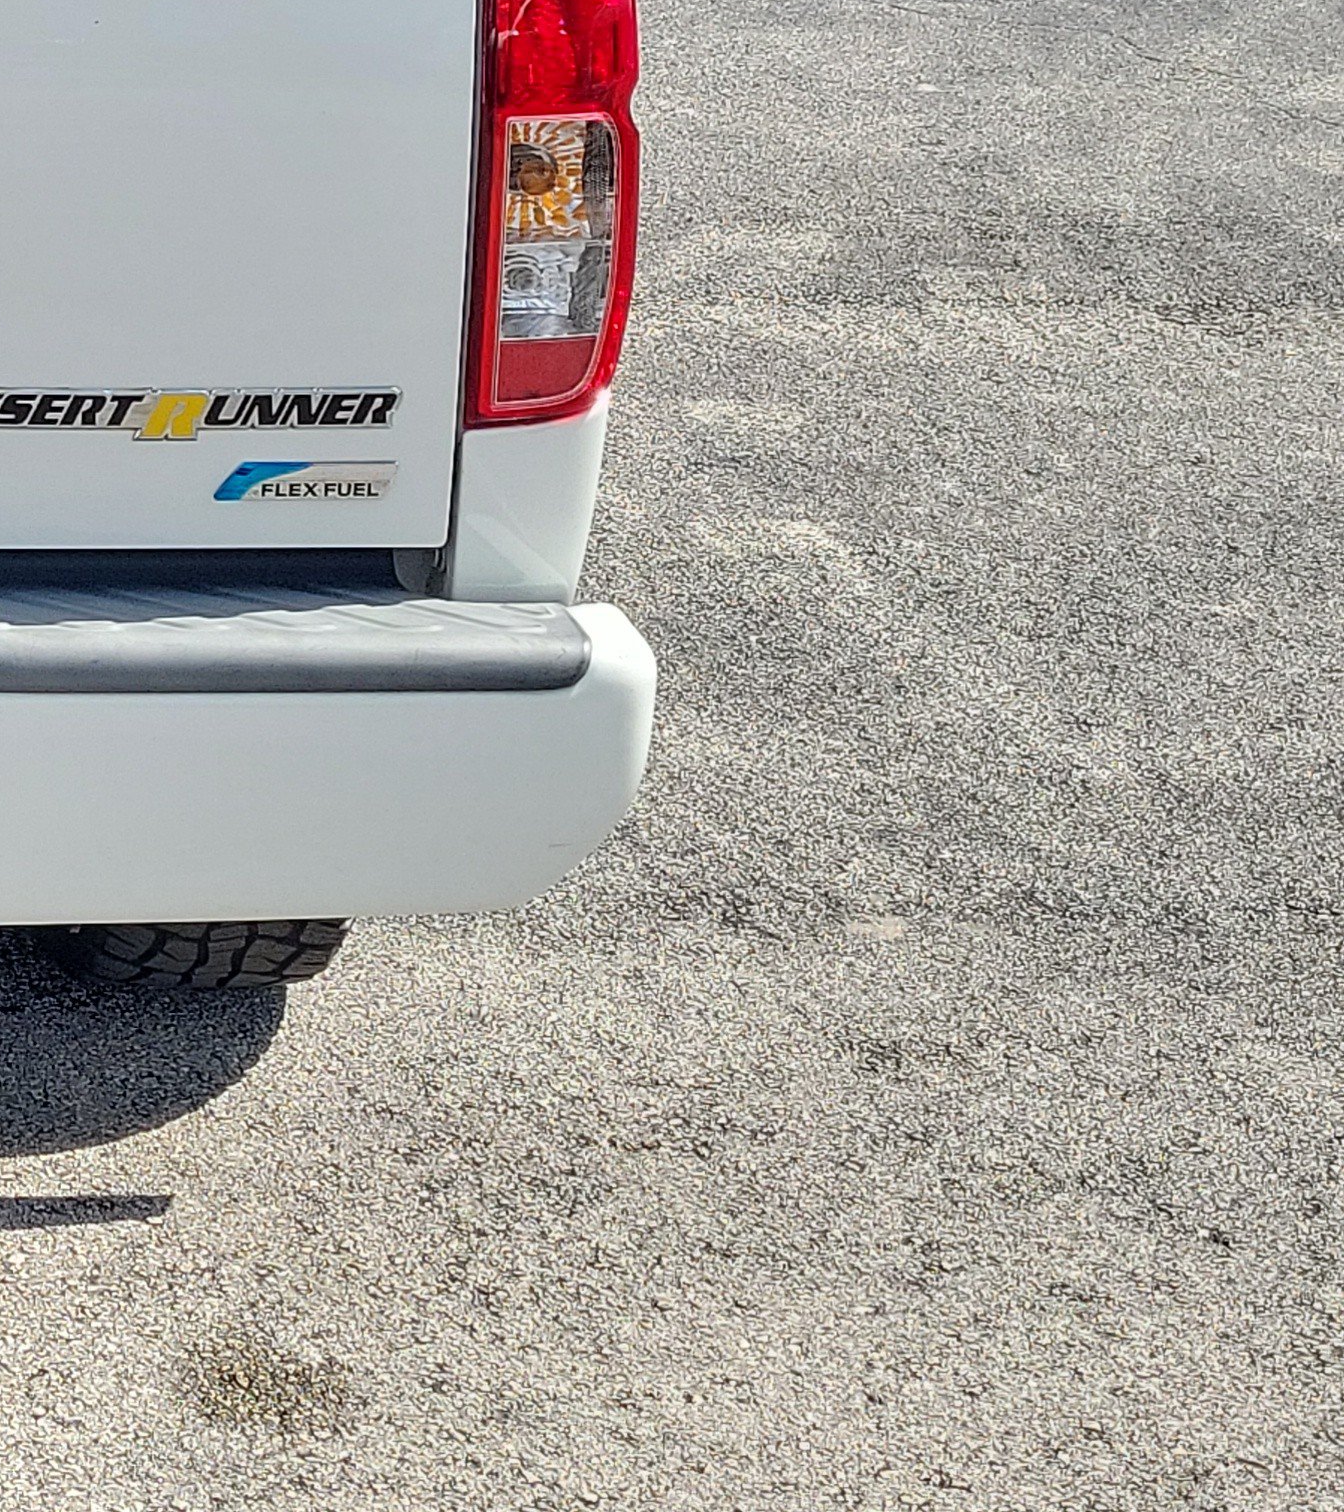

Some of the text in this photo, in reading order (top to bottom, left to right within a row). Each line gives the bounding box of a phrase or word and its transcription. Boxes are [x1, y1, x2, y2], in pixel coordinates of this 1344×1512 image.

[134, 389, 400, 441] RUNNER
[261, 482, 380, 498] FLEX FUEL
